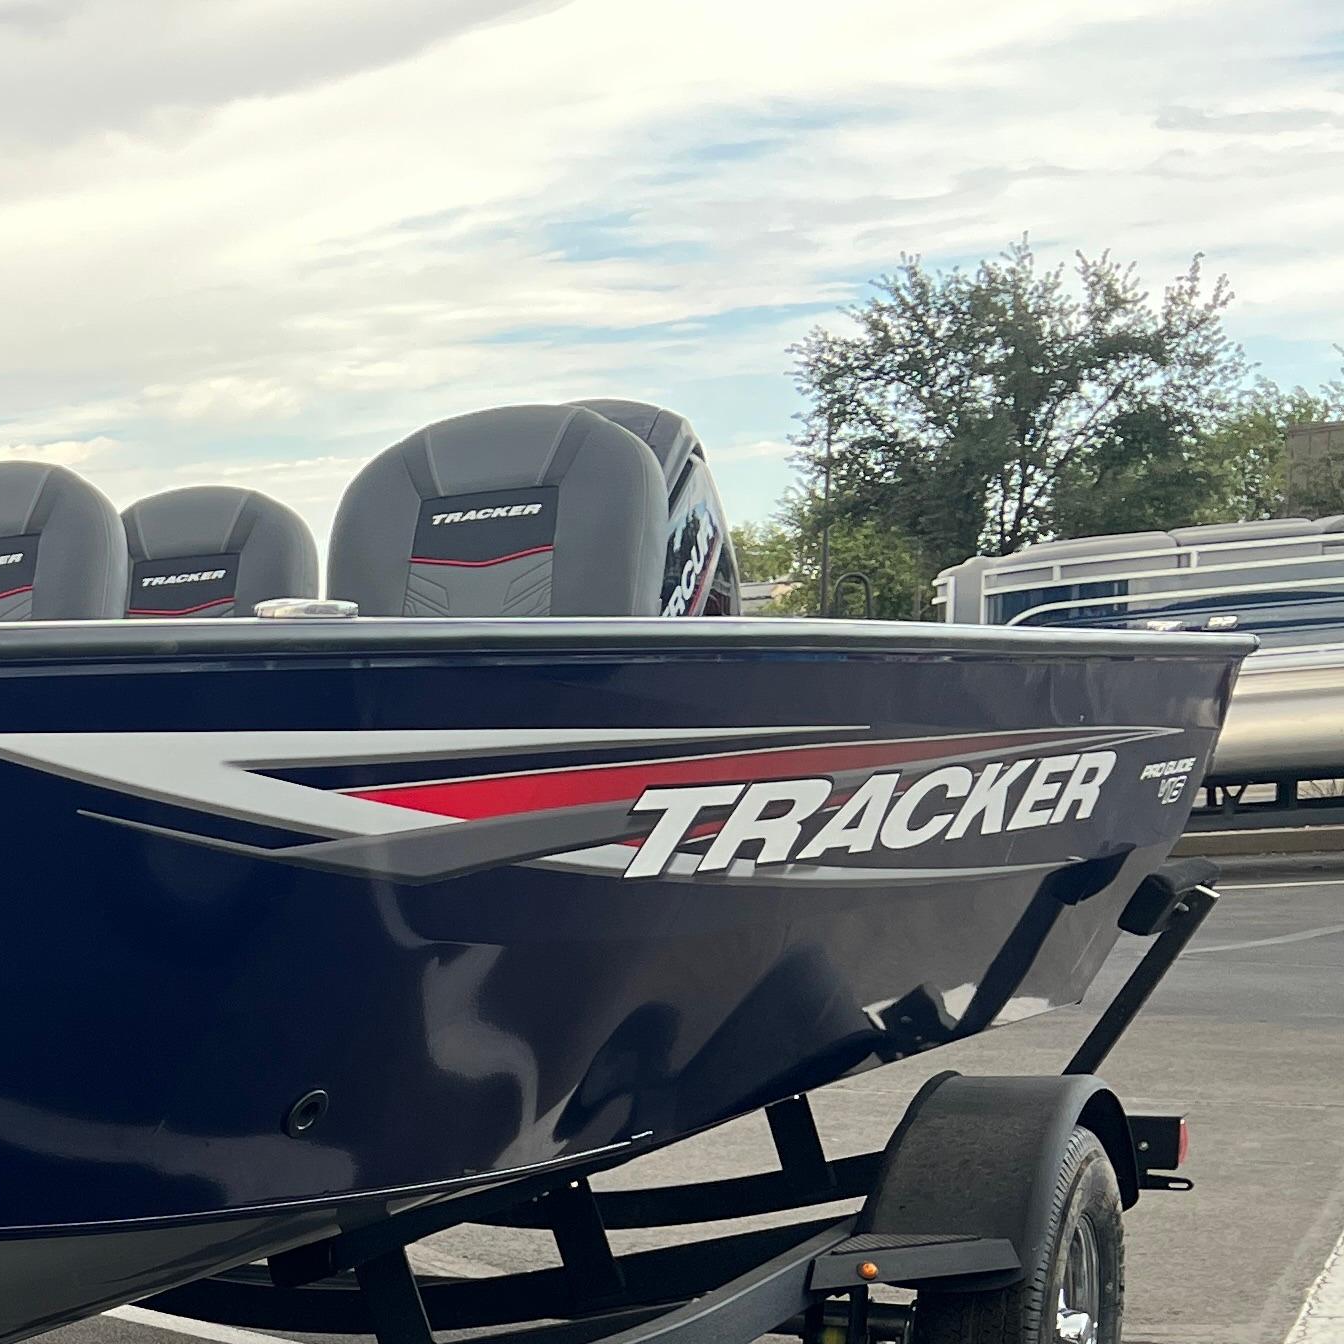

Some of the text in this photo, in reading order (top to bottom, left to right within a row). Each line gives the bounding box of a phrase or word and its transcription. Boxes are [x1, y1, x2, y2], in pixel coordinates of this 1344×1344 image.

[431, 503, 543, 525] TRACKER
[142, 569, 227, 588] TRACKER
[624, 750, 1117, 879] TRACKER
